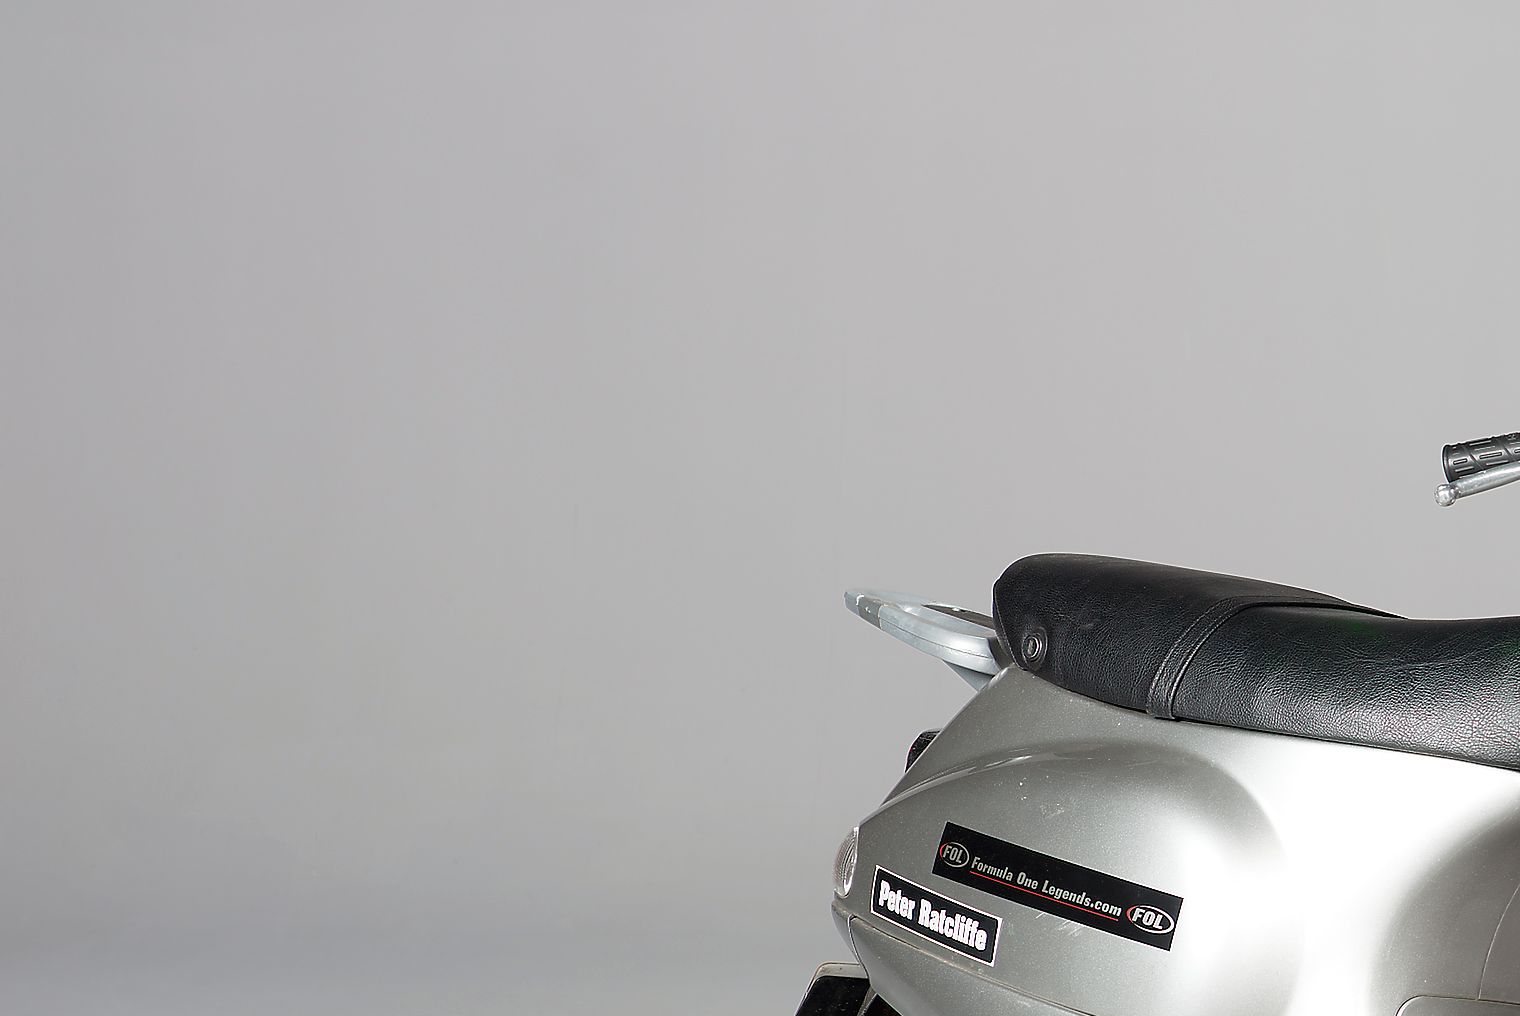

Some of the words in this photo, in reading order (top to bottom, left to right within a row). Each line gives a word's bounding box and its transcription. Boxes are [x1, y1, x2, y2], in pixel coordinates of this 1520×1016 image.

[879, 880, 915, 920] Peter
[918, 898, 987, 951] Ratcliffe
[942, 844, 964, 863] FOL
[971, 857, 1013, 881] Formula
[1016, 872, 1039, 889] One
[1041, 880, 1122, 917] Legends.com
[1132, 907, 1163, 929] FOL
